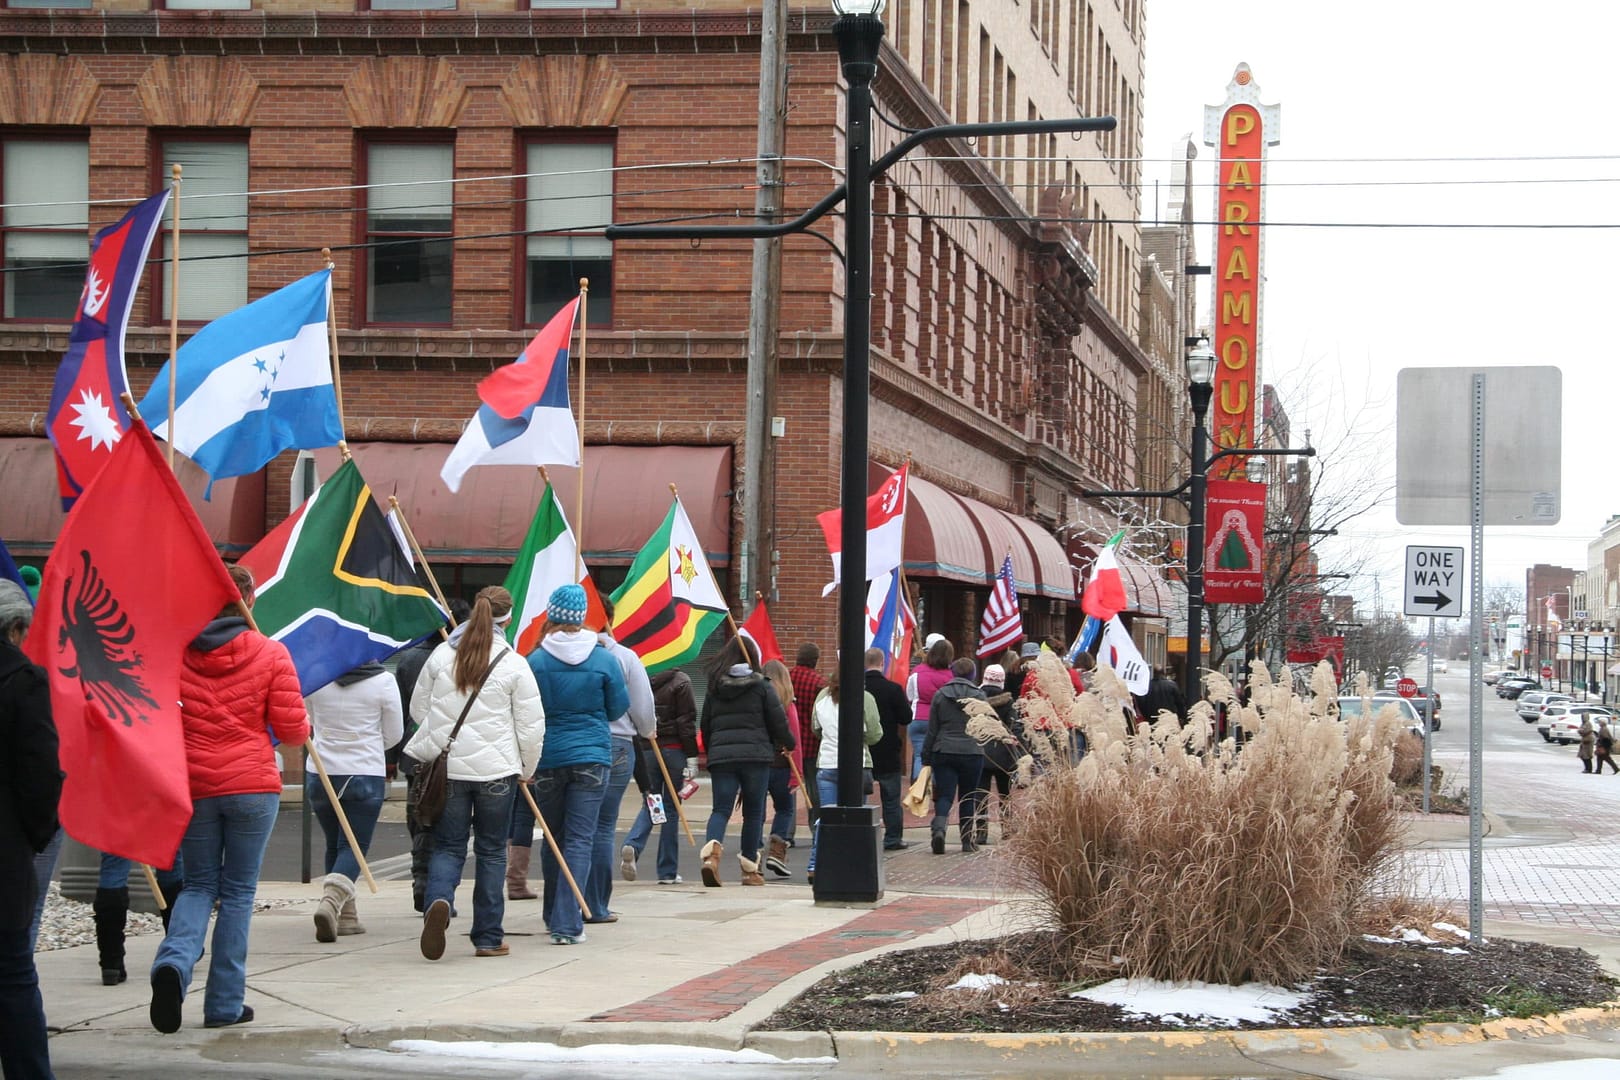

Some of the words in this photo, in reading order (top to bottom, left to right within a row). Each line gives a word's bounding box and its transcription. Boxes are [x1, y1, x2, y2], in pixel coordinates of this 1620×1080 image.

[1416, 551, 1453, 568] ONE
[1414, 570, 1454, 587] WAY
[1398, 683, 1416, 692] STOP
